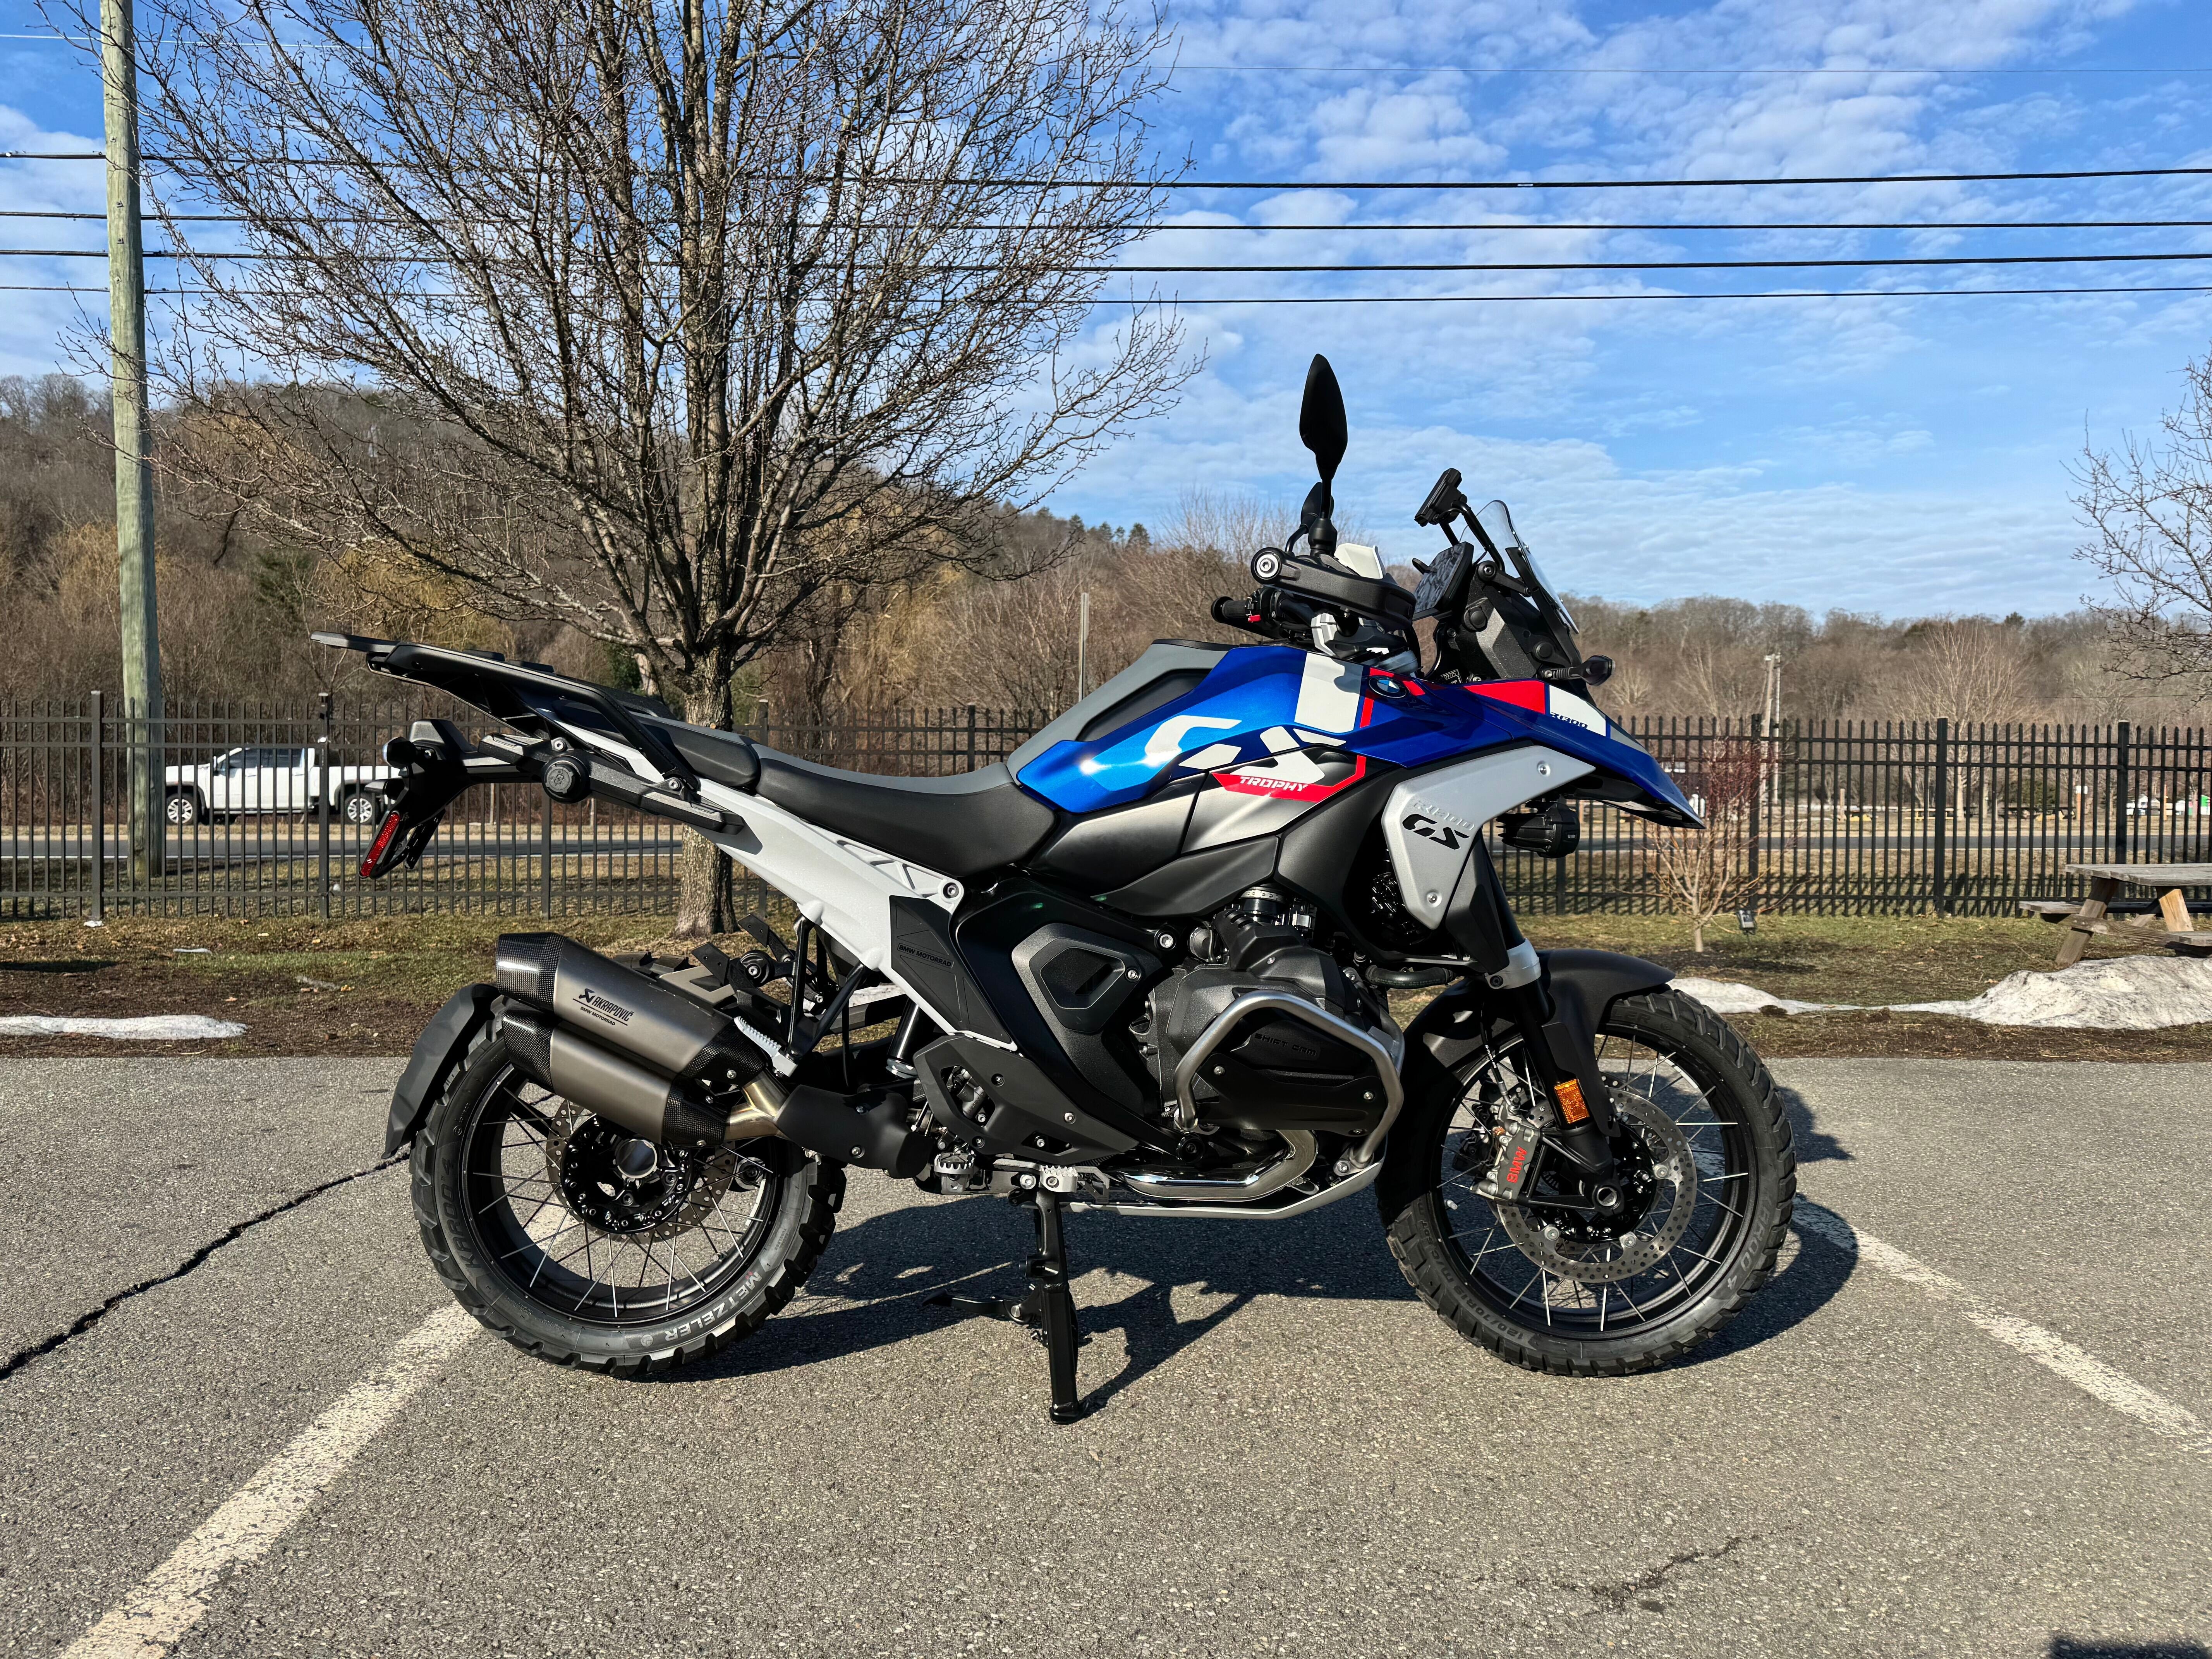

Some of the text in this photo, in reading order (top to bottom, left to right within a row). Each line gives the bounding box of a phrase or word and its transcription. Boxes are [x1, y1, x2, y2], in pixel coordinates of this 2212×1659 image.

[1240, 776, 1309, 792] TROPHY
[1402, 814, 1470, 850] GS
[899, 945, 951, 967] BMW MOTORRAD
[592, 1012, 615, 1025] MOTORRAD
[1254, 1033, 1317, 1056] SHIFT CAM
[1506, 1146, 1527, 1183] BMW
[665, 1271, 763, 1342] METZELER
